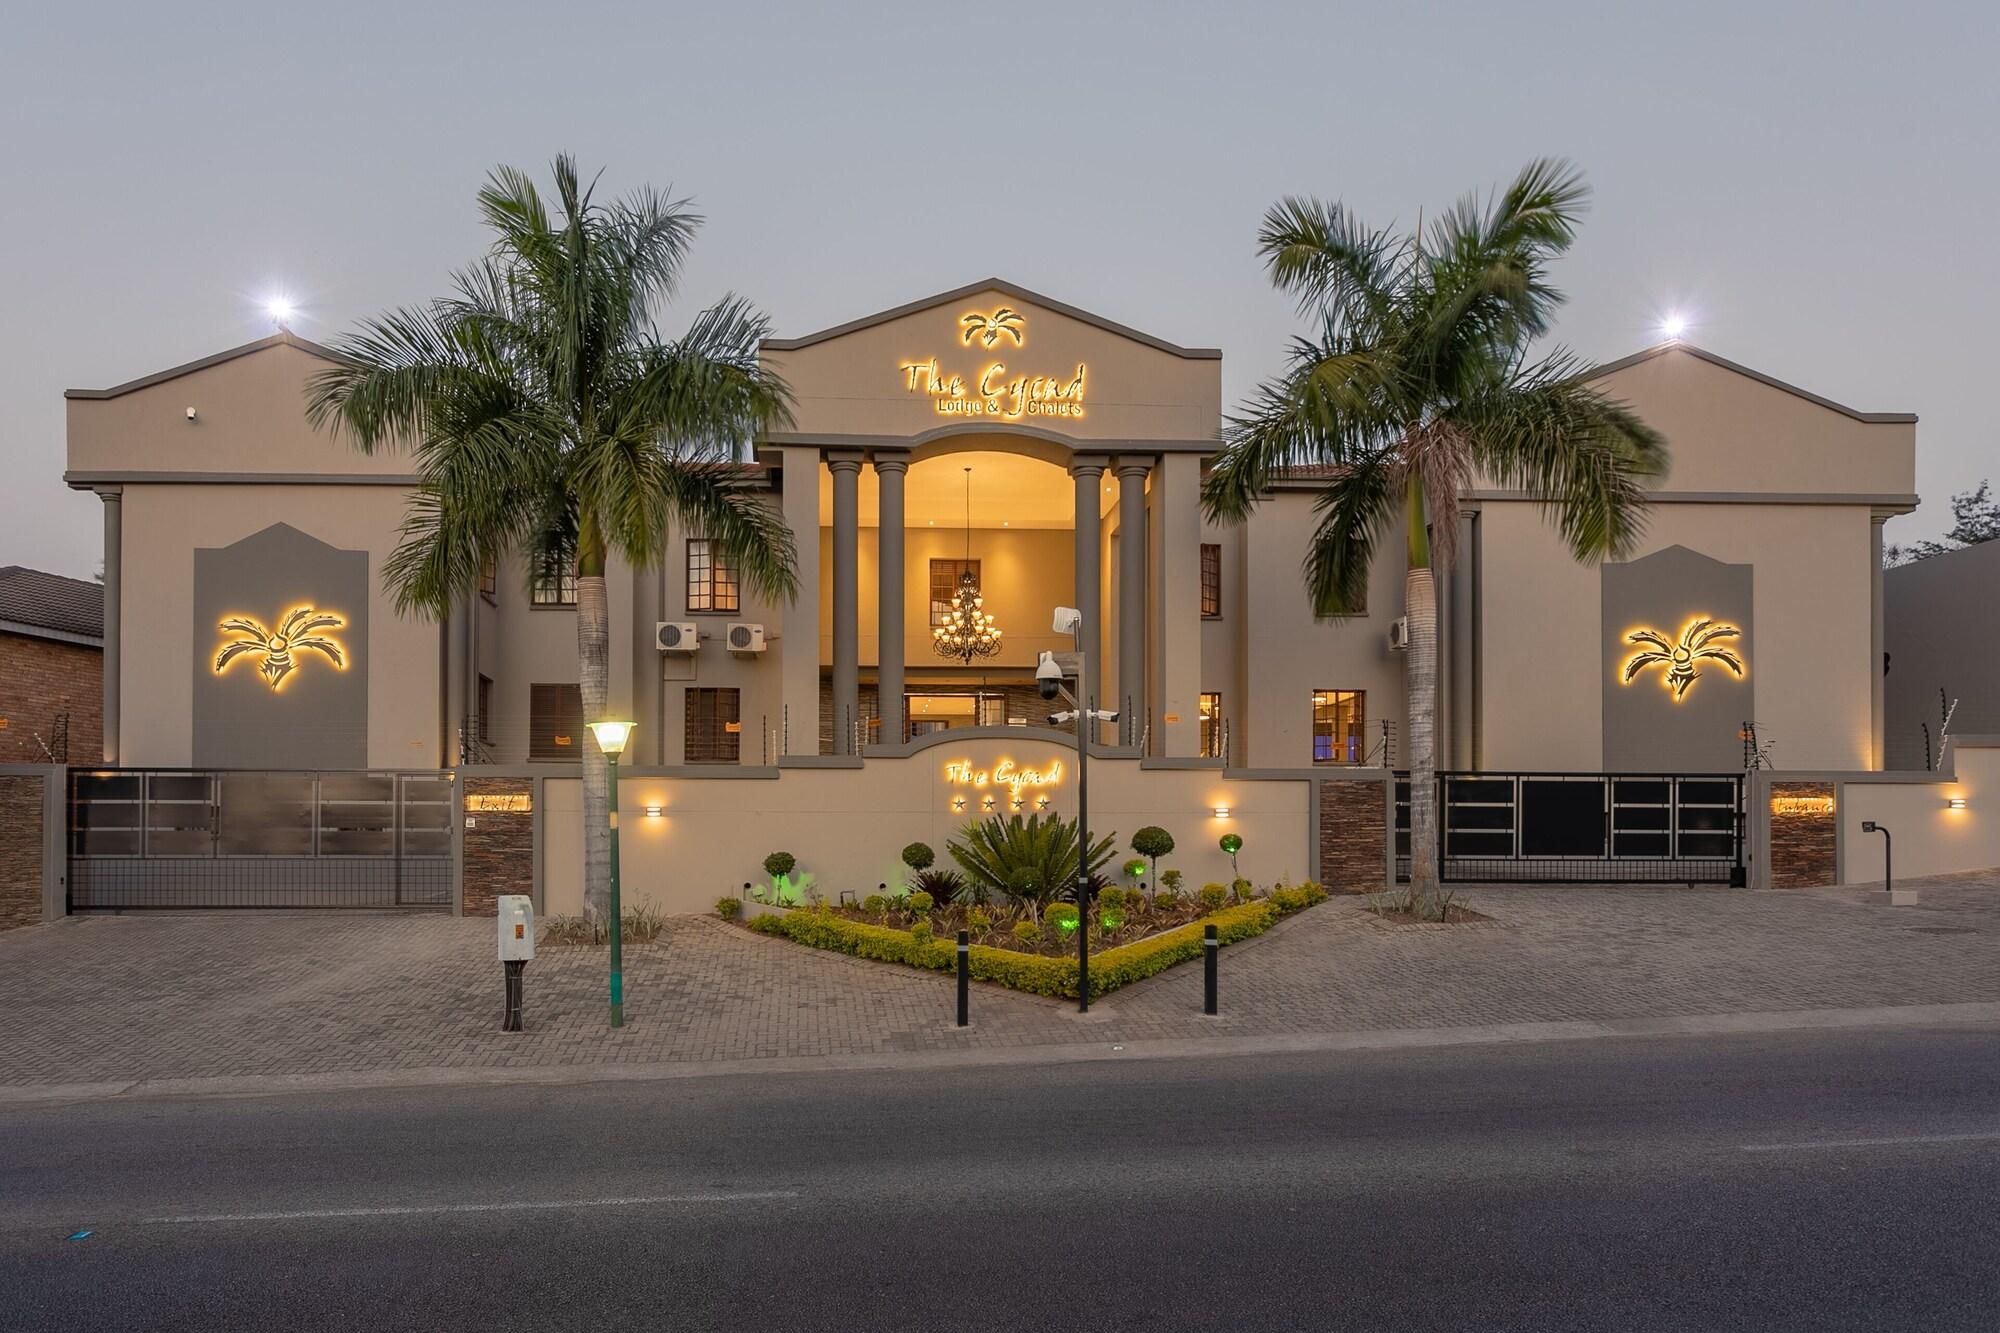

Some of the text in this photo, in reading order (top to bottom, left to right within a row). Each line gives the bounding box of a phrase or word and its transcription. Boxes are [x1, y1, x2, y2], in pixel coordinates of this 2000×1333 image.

[900, 358, 1085, 416] The Cycad
[938, 398, 1082, 415] Lodge & Chalets
[946, 760, 1061, 796] The Cycad
[480, 795, 515, 810] Exit
